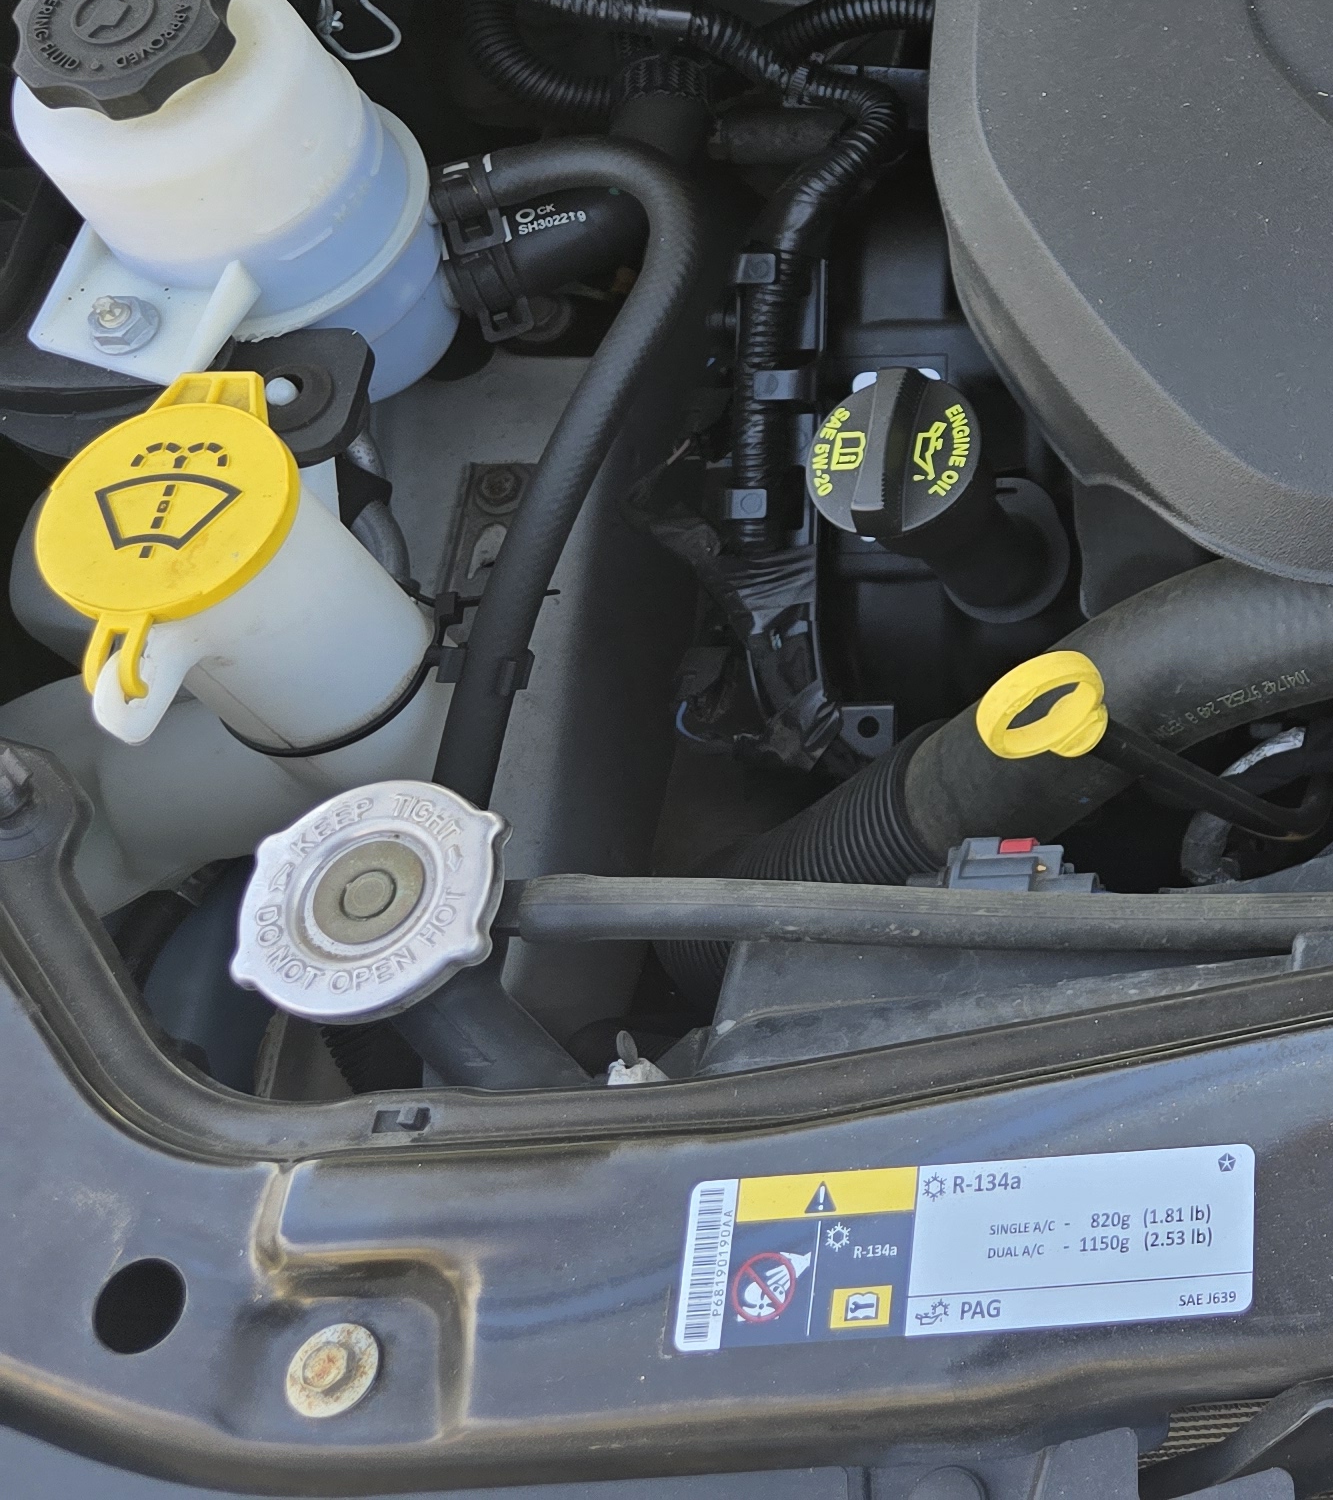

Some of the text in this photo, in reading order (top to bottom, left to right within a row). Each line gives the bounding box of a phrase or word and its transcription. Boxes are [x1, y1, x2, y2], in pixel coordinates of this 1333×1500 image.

[115, 3, 192, 69] APPROVED
[39, 41, 82, 70] FLUID
[812, 407, 850, 497] SAE 5W-20
[928, 404, 971, 496] ENGINE OIL
[290, 793, 462, 859] KEEP TIGHT
[255, 887, 466, 994] DO NOT OPEN HOT
[953, 1172, 1022, 1194] R-134a
[989, 1204, 1211, 1236] SINGLE A/C 820g (1.81 lb)
[853, 1244, 897, 1259] R-134a
[988, 1227, 1213, 1259] DUAL A/C 1150g (2.53 lb)
[960, 1299, 1001, 1320] PAG
[1179, 1291, 1236, 1307] SAE J639
